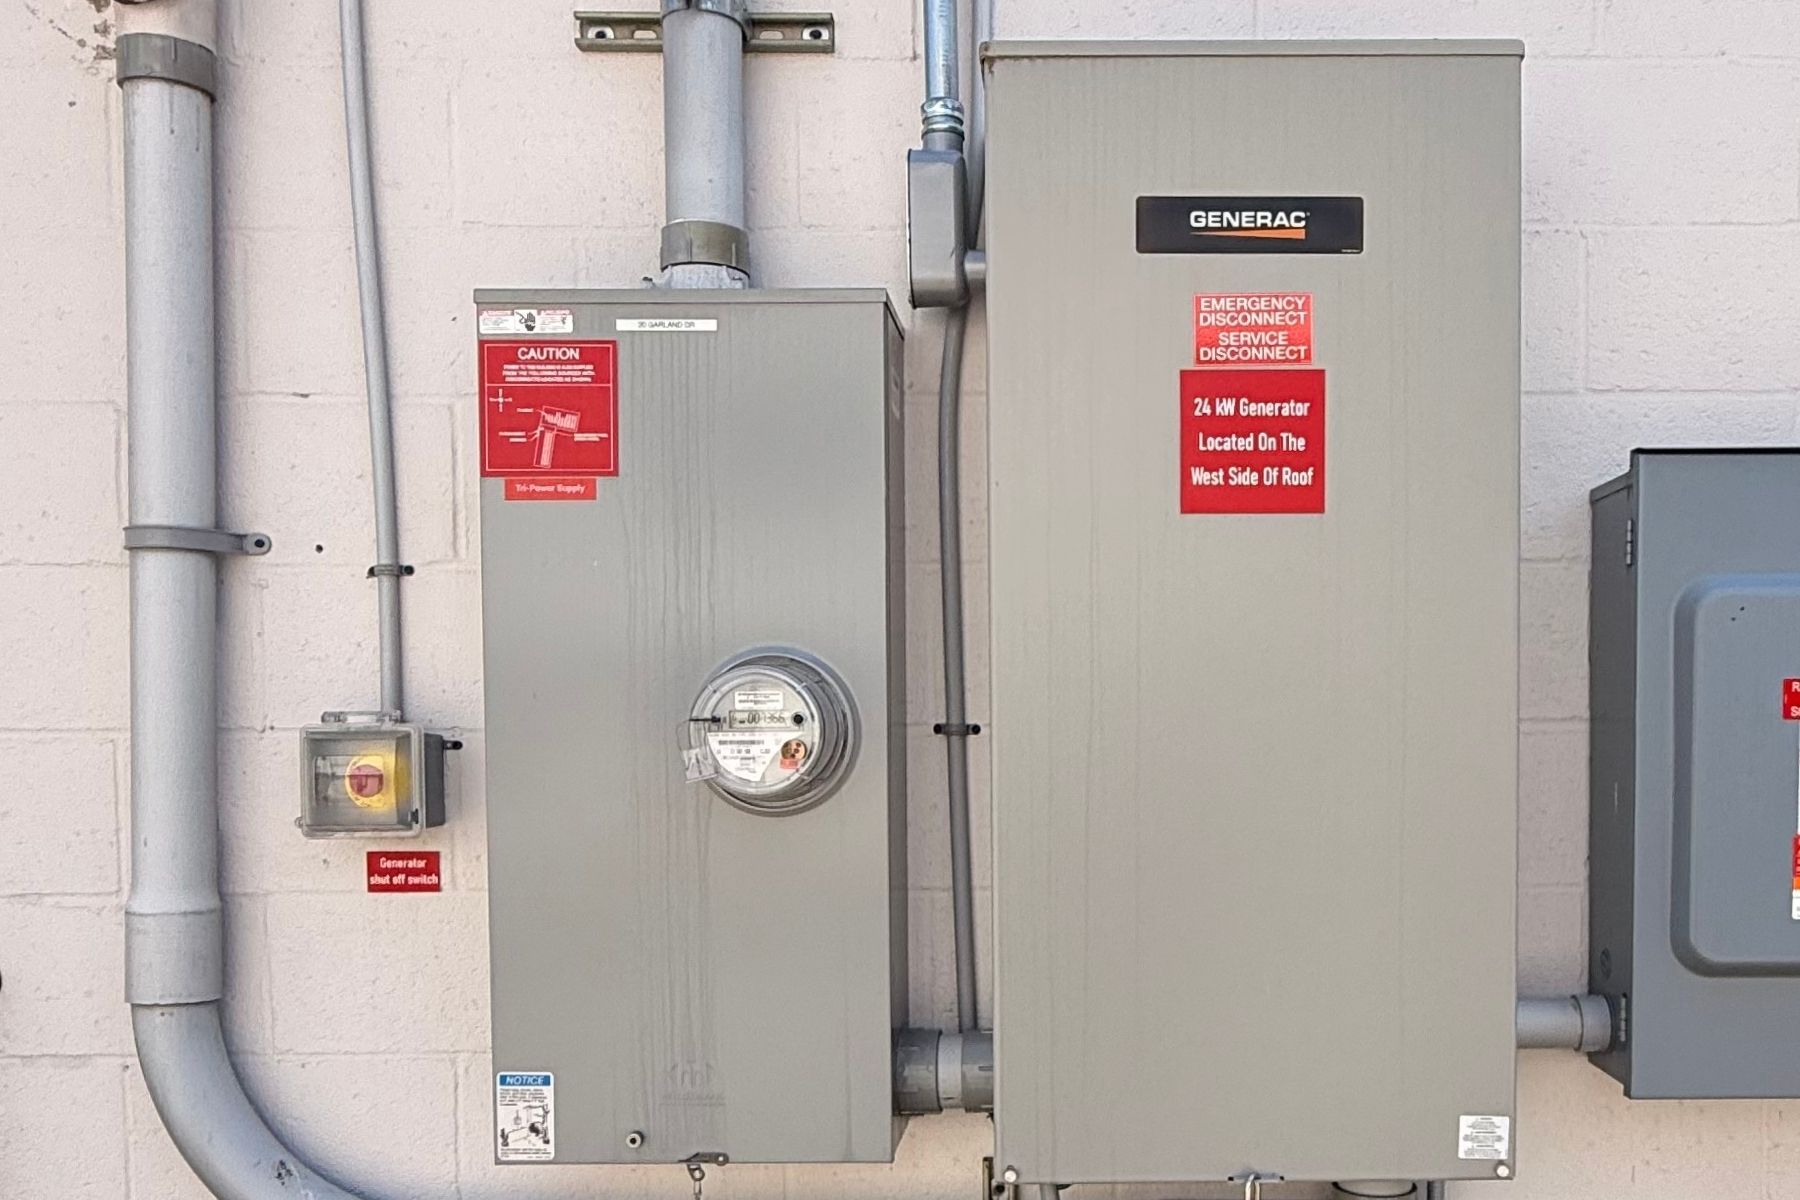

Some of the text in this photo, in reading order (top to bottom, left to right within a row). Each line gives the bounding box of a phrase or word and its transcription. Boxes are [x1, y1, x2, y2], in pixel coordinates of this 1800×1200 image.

[1189, 211, 1306, 227] GENERAC
[1200, 297, 1305, 311] EMERGENCY
[1199, 311, 1307, 326] DISCONNECT
[1218, 331, 1288, 346] SERVICE
[517, 347, 580, 360] CAUTION
[1200, 346, 1308, 361] DISCONNECT
[1193, 397, 1310, 416] 24 kW Generator
[1198, 432, 1306, 451] Located On The
[1190, 467, 1314, 486] West Side Of Roof
[515, 484, 586, 494] Tri-Power Supply
[379, 857, 427, 868] Generator
[369, 873, 438, 885] shut off switch
[505, 1076, 545, 1086] NOTICE
